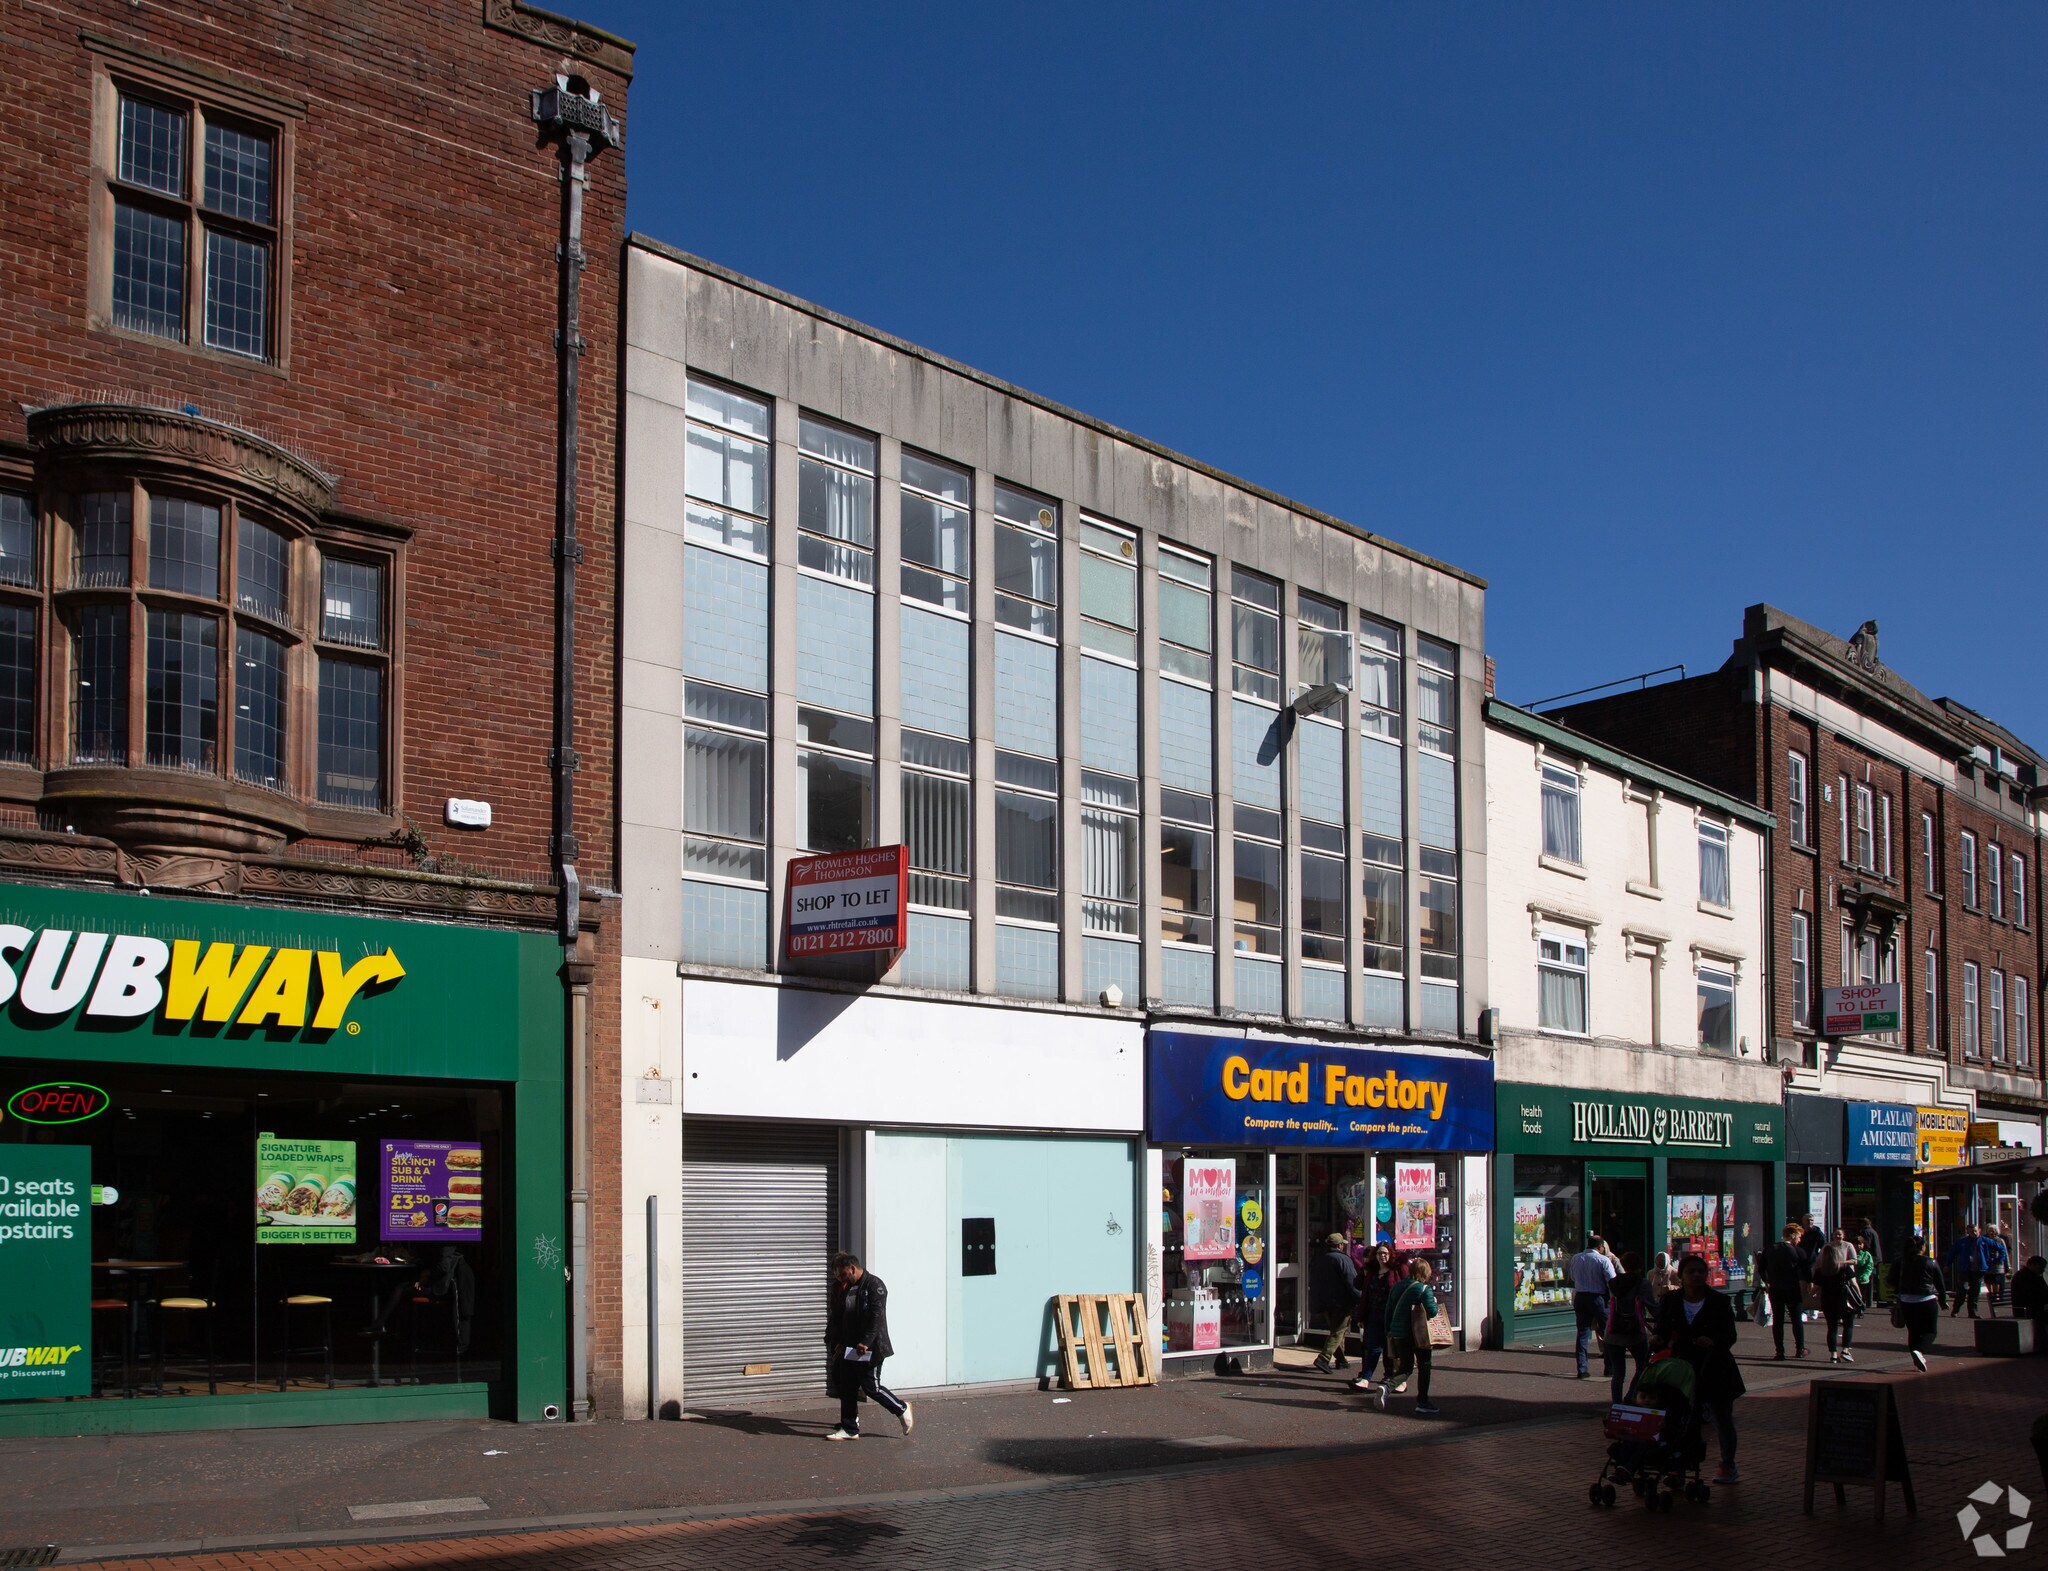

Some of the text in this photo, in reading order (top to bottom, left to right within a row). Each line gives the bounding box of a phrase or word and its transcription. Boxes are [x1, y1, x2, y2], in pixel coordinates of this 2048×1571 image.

[814, 851, 896, 871] ROWLEY HUGHES
[813, 865, 872, 881] THOMPSON
[796, 889, 891, 913] SHOP TO LET
[806, 916, 879, 932] www.rhtretail.co.uk
[792, 927, 894, 951] 0121 212 7800
[1841, 987, 1881, 1000] SHOP
[1836, 999, 1887, 1012] TO LET
[1221, 1055, 1448, 1121] Card Factory
[20, 1092, 95, 1114] OPEN
[1520, 1104, 1543, 1117] health
[1243, 1115, 1285, 1129] Compare
[1286, 1117, 1301, 1129] the
[1349, 1120, 1386, 1134] Compare
[1387, 1122, 1401, 1133] the
[1522, 1120, 1542, 1134] foods
[1572, 1101, 1733, 1148] HOLLAND & BARRETT
[1754, 1121, 1771, 1131] natural
[1919, 1112, 1945, 1131] MOBILE
[1946, 1114, 1967, 1132] CLINIC
[1752, 1134, 1773, 1144] remedies
[260, 1143, 322, 1153] SIGNATURE
[260, 1153, 344, 1163] LOADED WRAPS
[391, 1157, 436, 1166] SIX-INCH
[1873, 1152, 1886, 1160] PARK
[1887, 1152, 1901, 1160] STREET
[1982, 1151, 2022, 1160] SHOES
[391, 1167, 431, 1175] SUB & A
[391, 1175, 423, 1184] DRINK
[14, 1178, 76, 1196] seats
[391, 1194, 431, 1210] £3.50
[1246, 1211, 1259, 1222] 29p
[1515, 1211, 1538, 1226] Spring
[1679, 1207, 1697, 1220] Spring
[260, 1230, 352, 1240] BIGGER IS BETTER
[1521, 1224, 1534, 1233] Sale
[11, 1369, 66, 1378] Discovering
